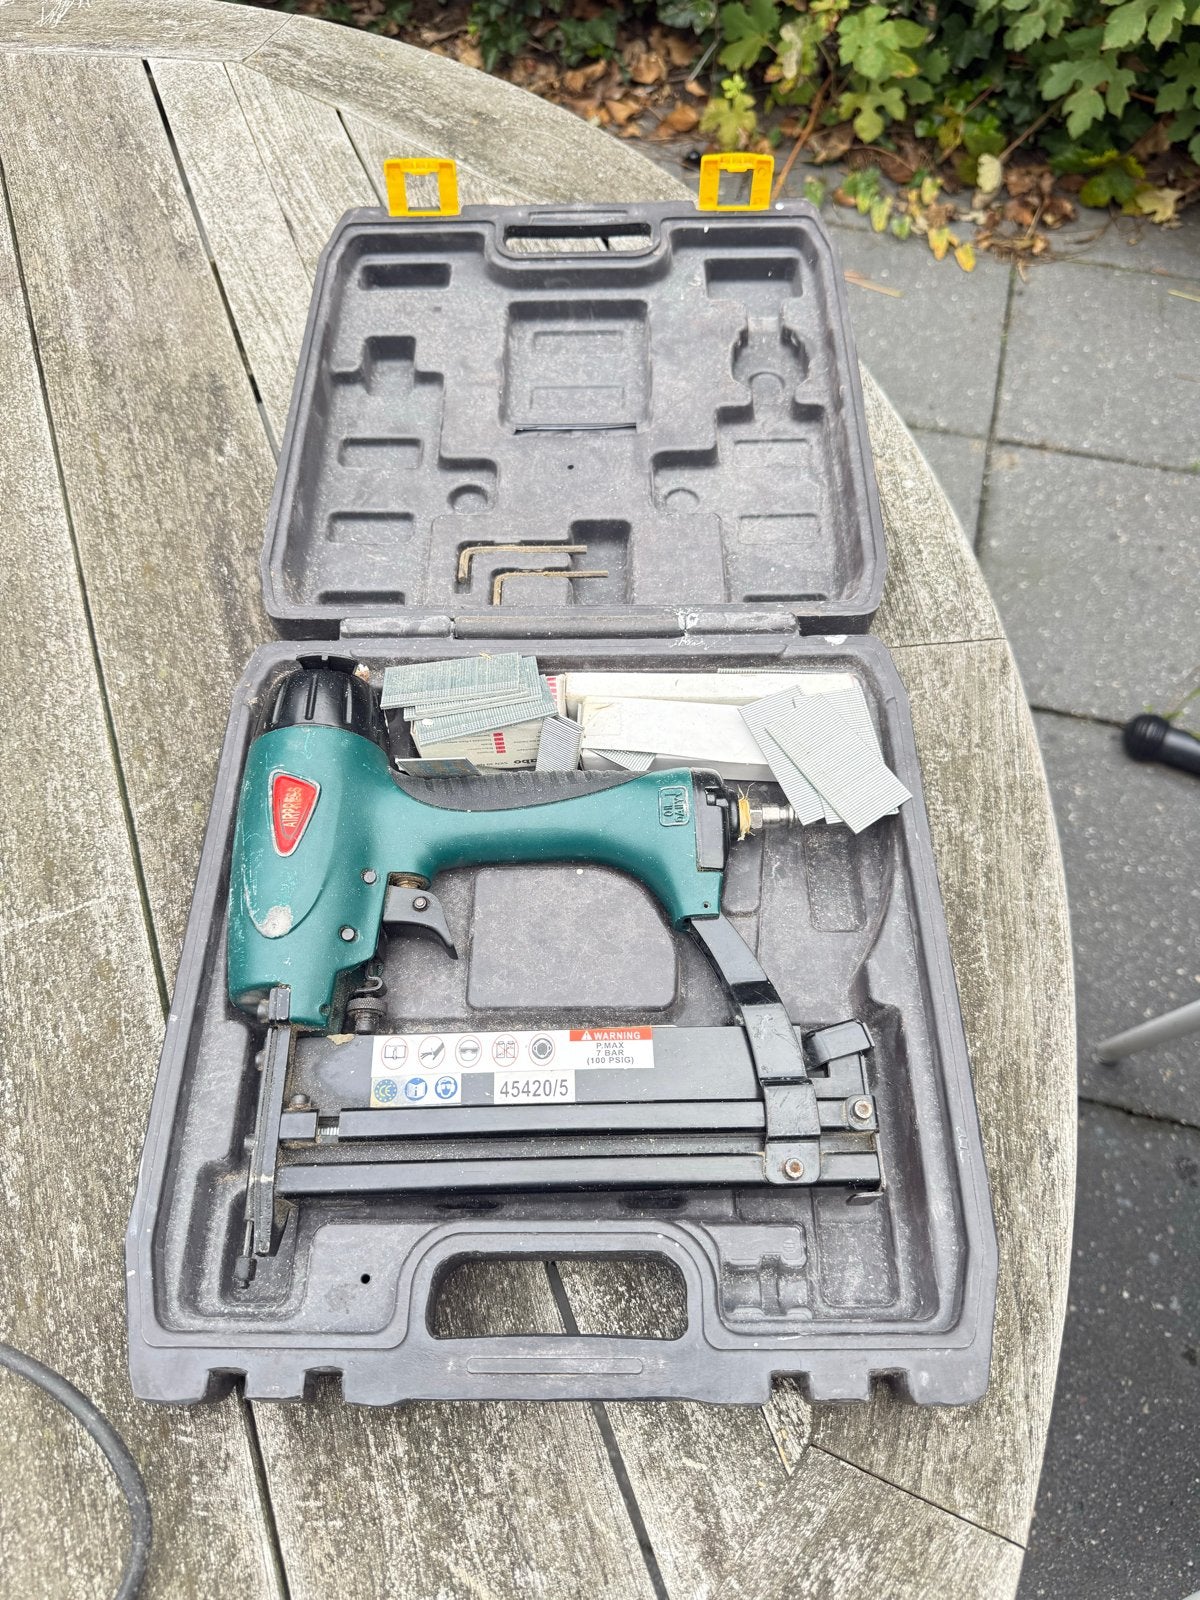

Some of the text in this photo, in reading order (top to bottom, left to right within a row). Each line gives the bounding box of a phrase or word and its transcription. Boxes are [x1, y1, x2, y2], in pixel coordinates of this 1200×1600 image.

[281, 787, 302, 827] AIRPRESS
[593, 1031, 641, 1040] WARNING
[604, 1049, 624, 1057] BAR
[586, 1056, 634, 1065] (100 PSIG)
[499, 1079, 569, 1098] 45420/5
